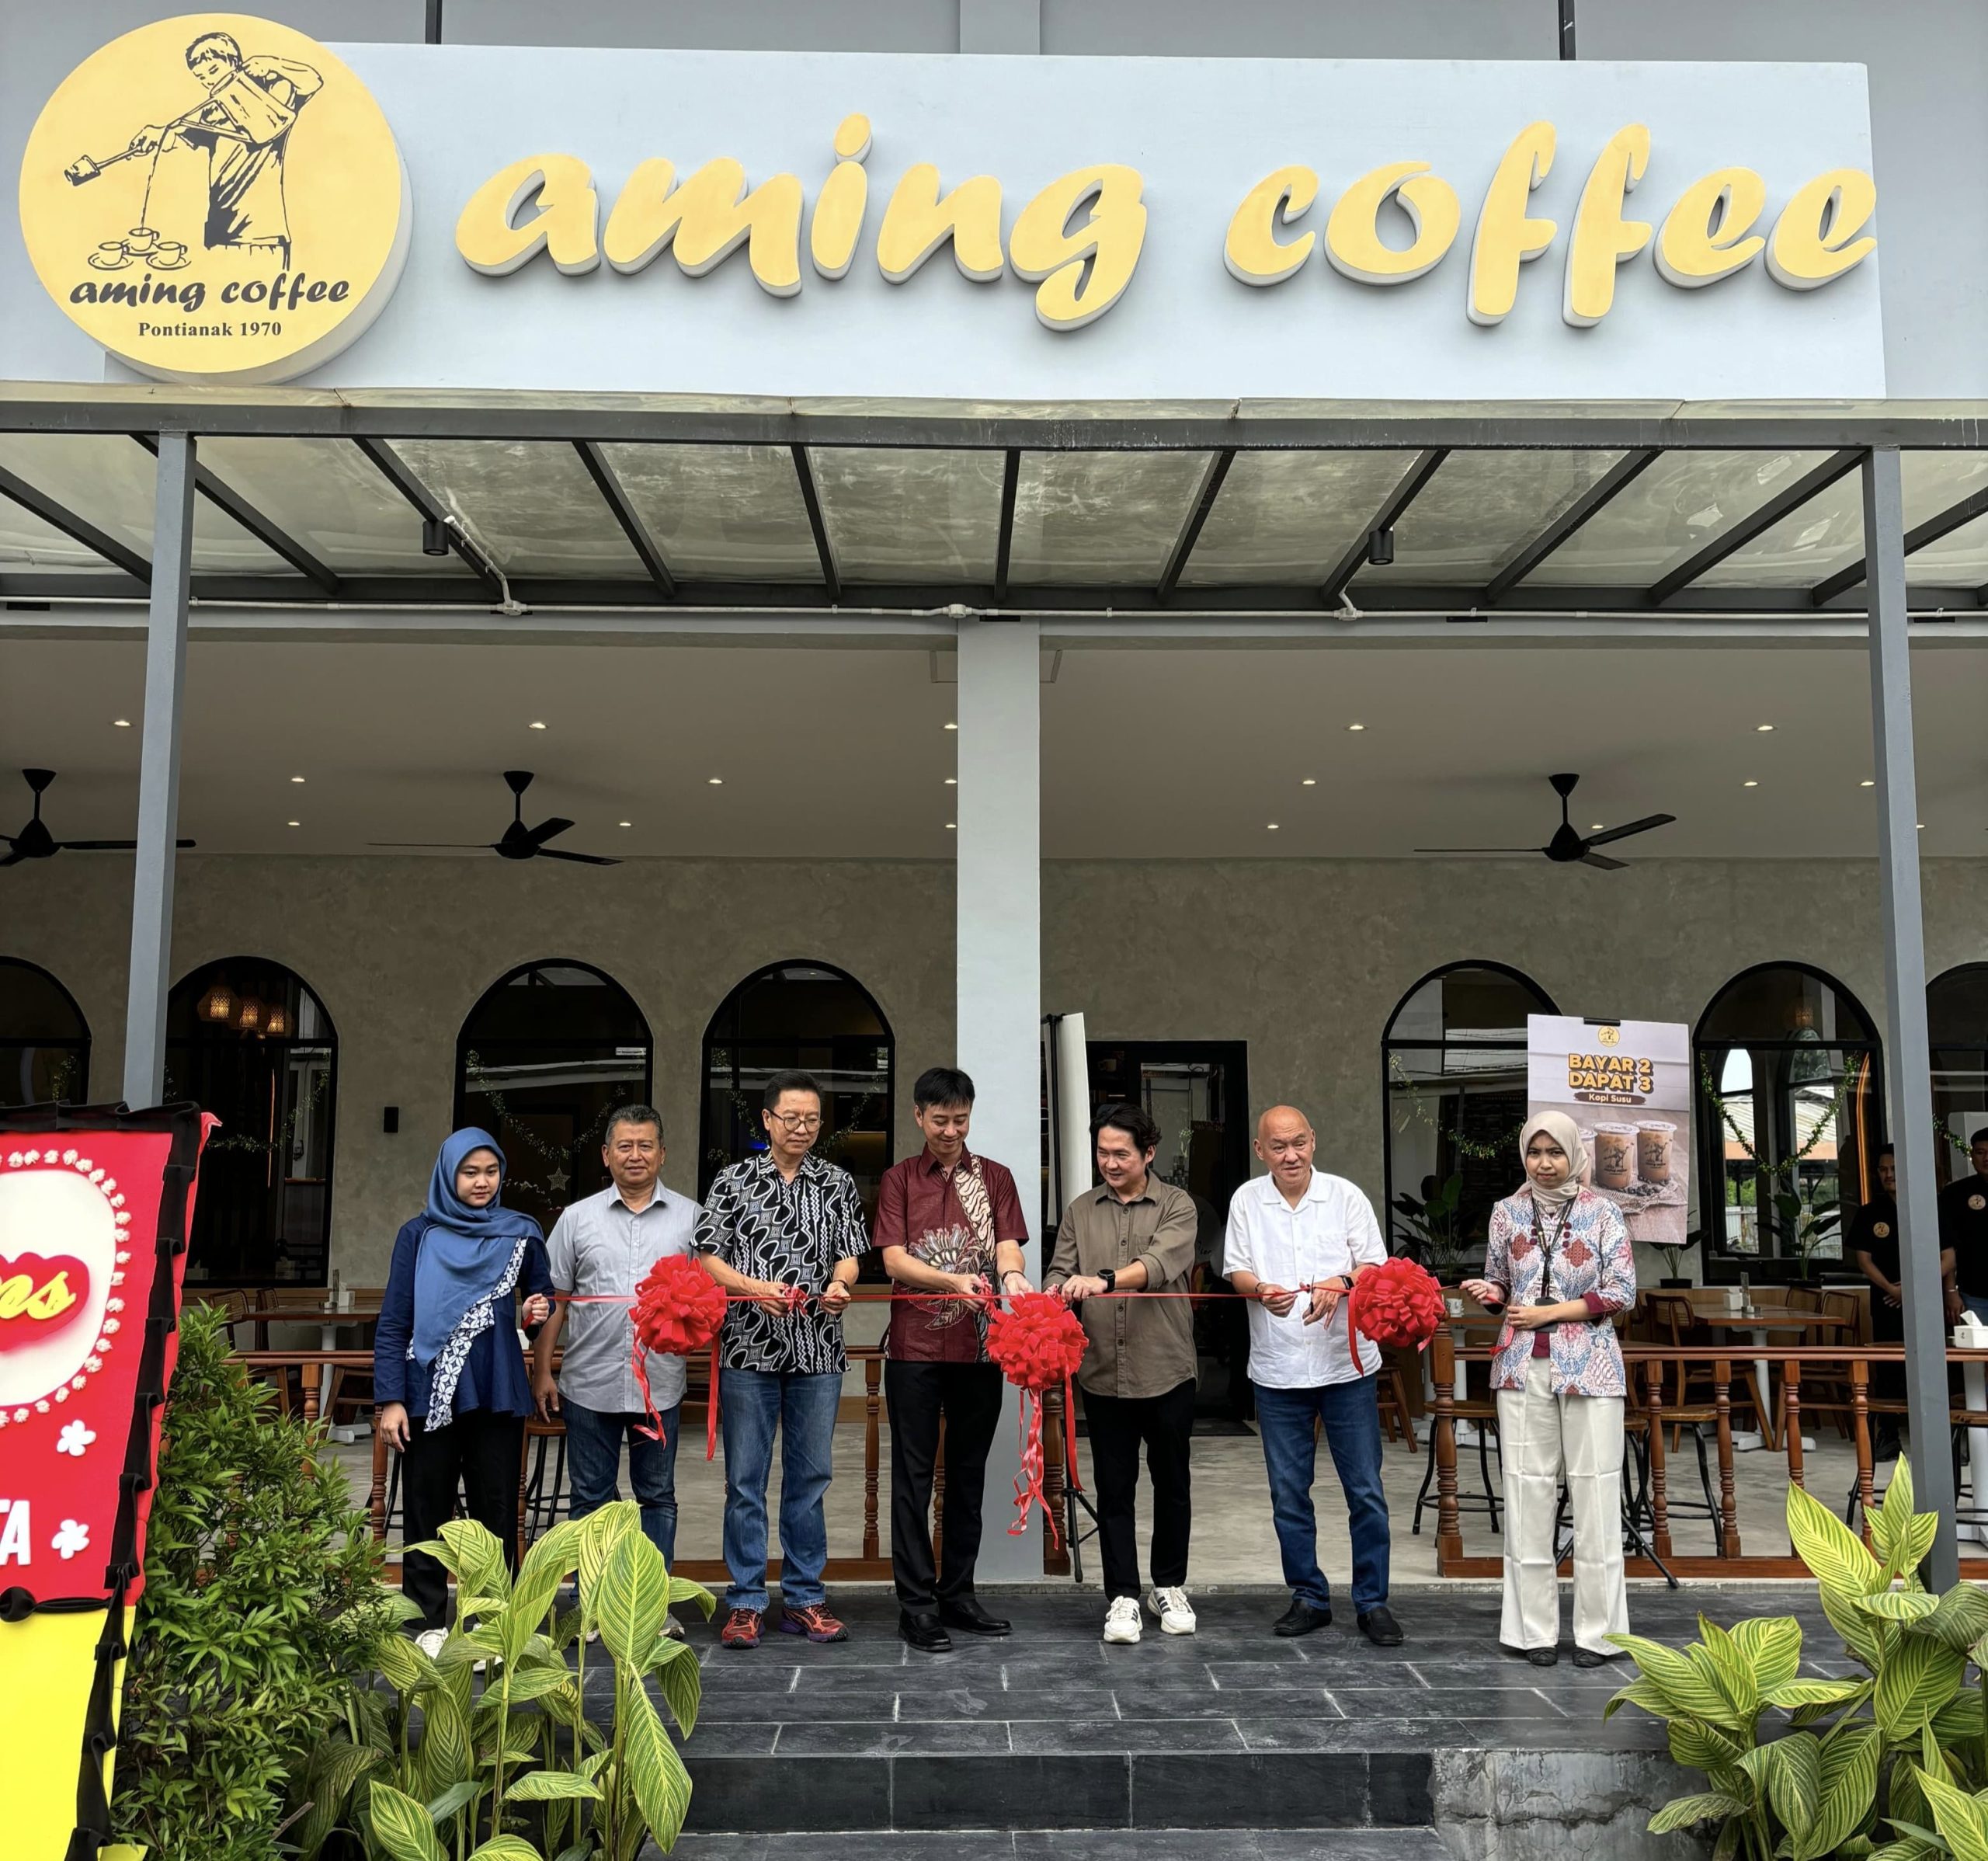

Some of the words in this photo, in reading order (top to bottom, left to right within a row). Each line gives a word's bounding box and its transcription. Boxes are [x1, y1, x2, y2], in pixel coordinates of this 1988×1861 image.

[456, 114, 1149, 332] aming
[1227, 122, 1876, 327] coffee
[70, 273, 206, 312] aming
[221, 273, 349, 311] coffee
[139, 322, 233, 337] Pontianak
[241, 322, 282, 336] 1970
[1568, 1054, 1635, 1073] BAYAR
[1639, 1059, 1652, 1075] 2
[1569, 1072, 1635, 1091] DAPAT
[1639, 1076, 1653, 1093] 3
[1589, 1093, 1609, 1104] Kopi
[1611, 1094, 1632, 1104] Susu
